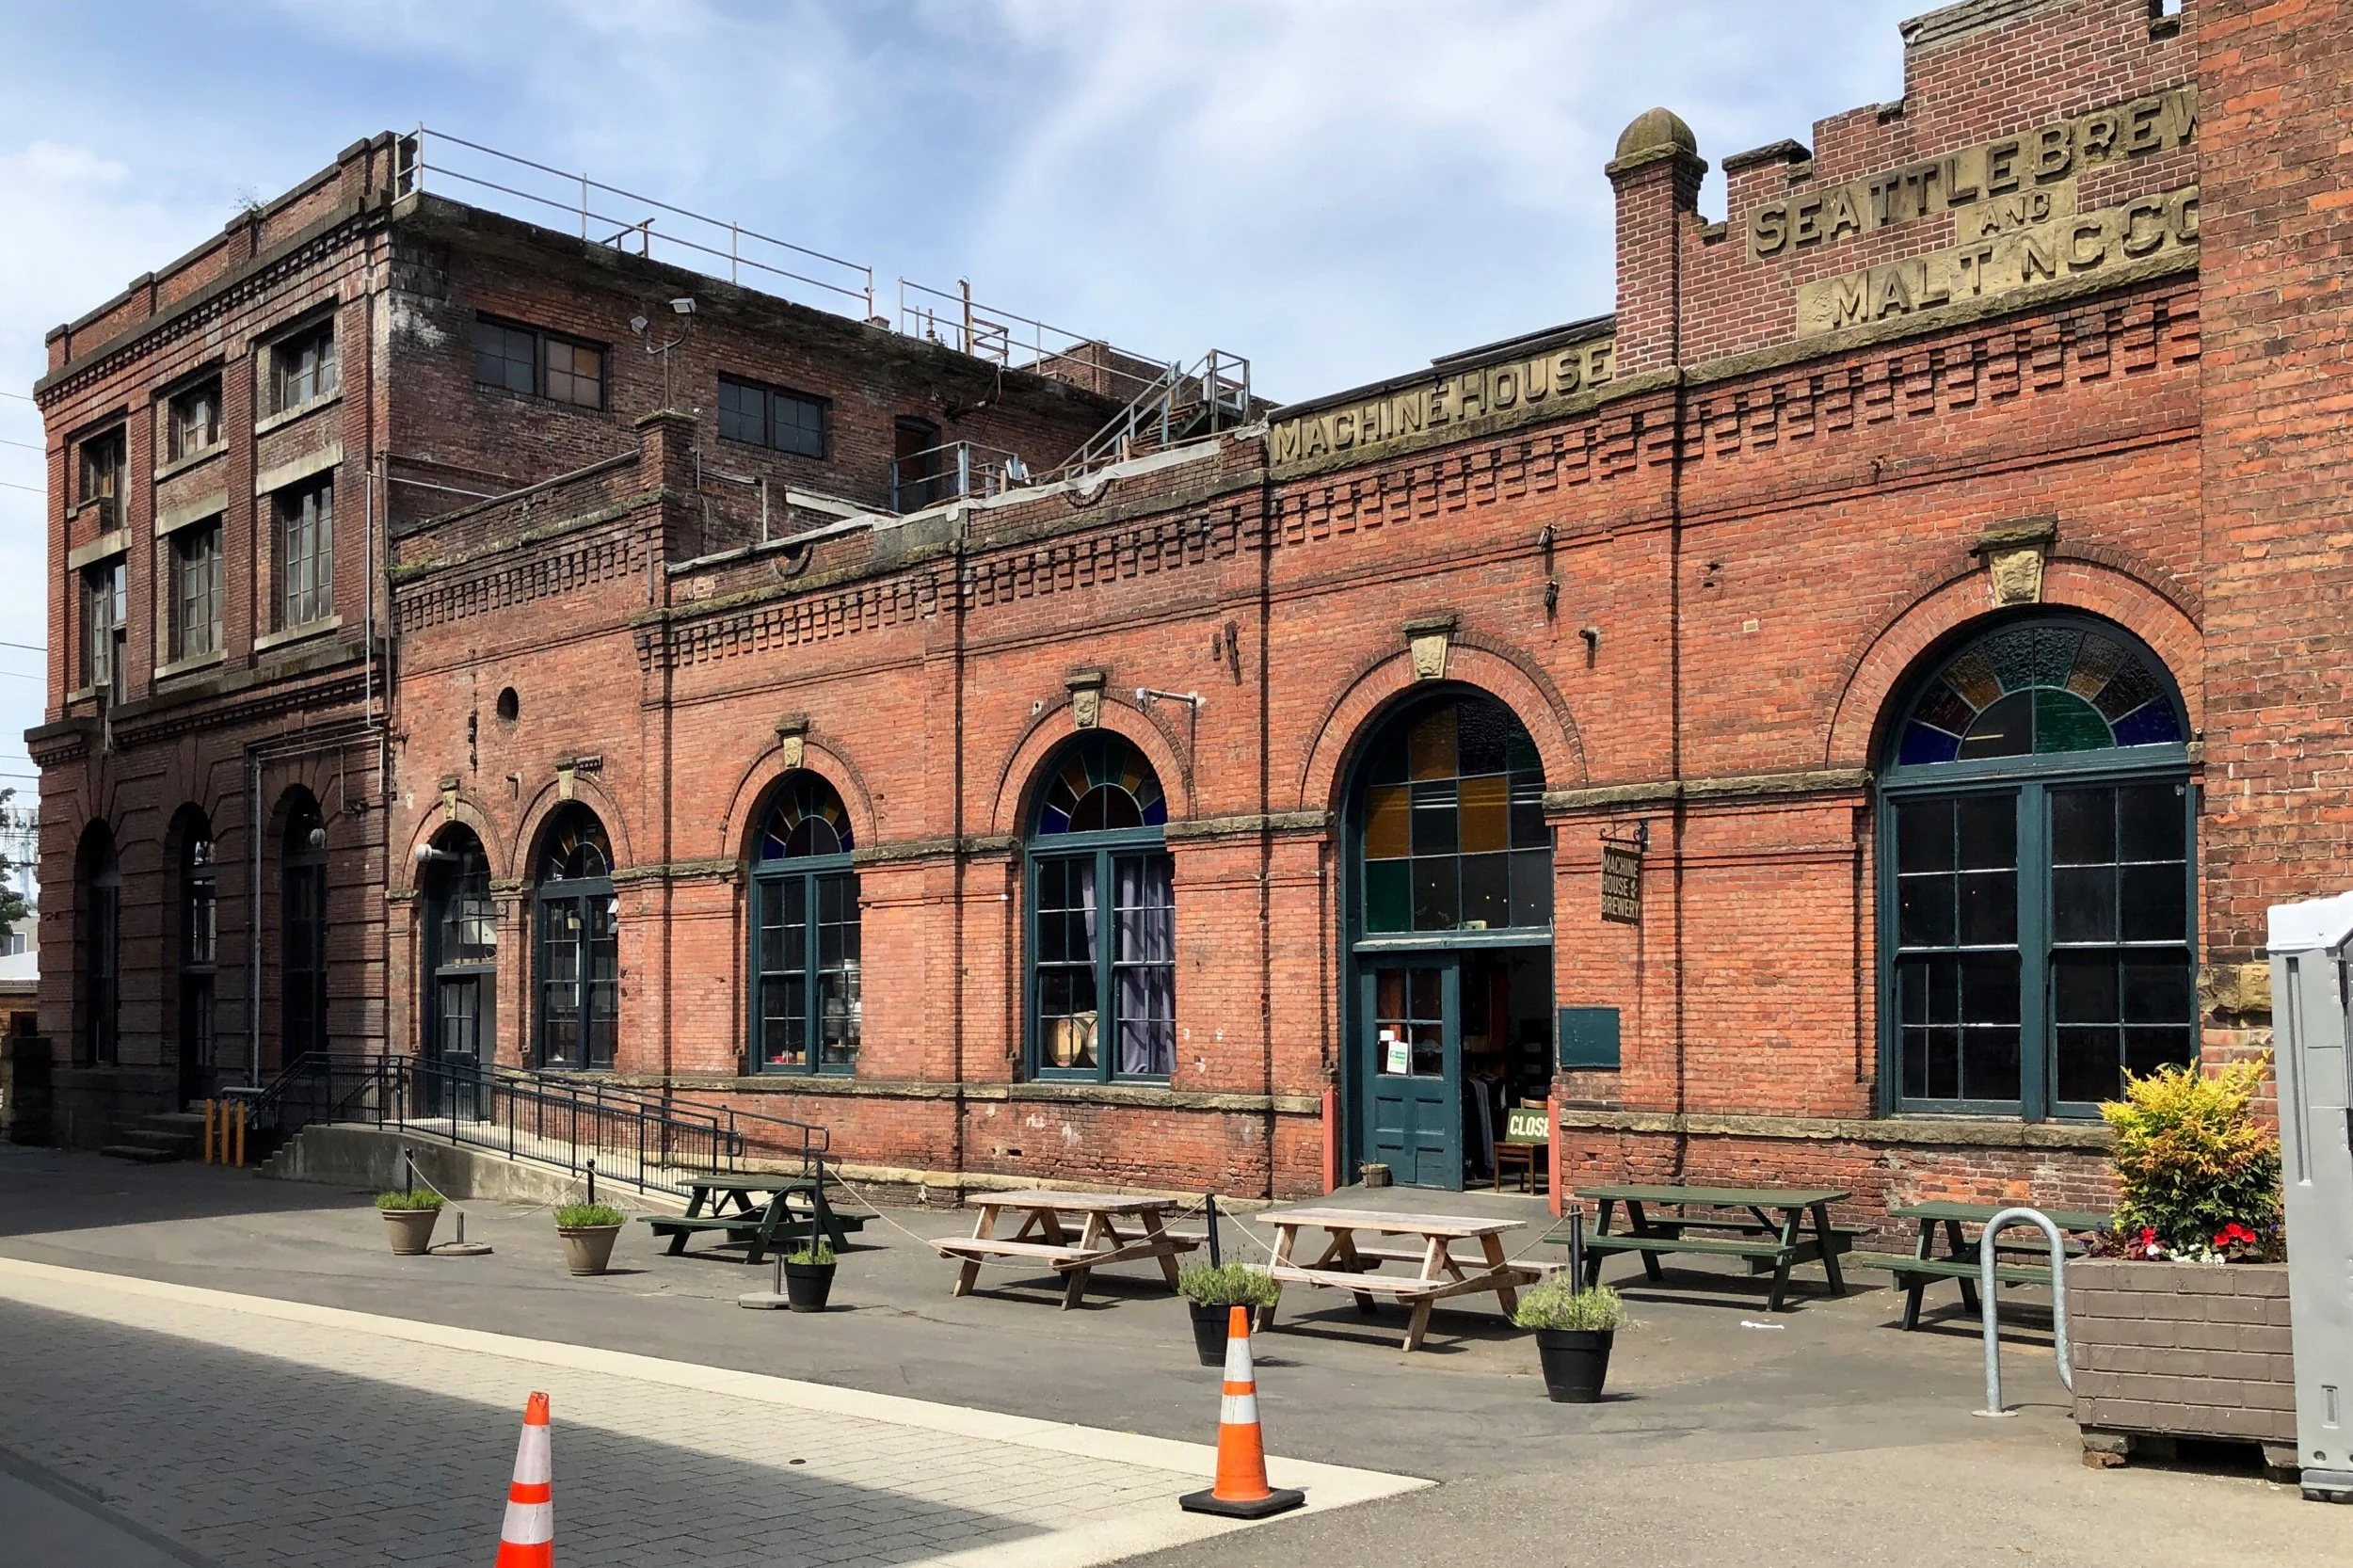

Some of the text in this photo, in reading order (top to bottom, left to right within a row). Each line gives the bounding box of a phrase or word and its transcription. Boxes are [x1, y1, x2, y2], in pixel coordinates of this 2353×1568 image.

[1754, 142, 2019, 259] SEATTLE
[1981, 188, 2050, 235] AND
[1273, 342, 1613, 463] MACHINE HOUSE
[1603, 853, 1639, 878] MACHINE
[1602, 873, 1629, 897] HOUSE
[1602, 894, 1640, 920] BREWERY
